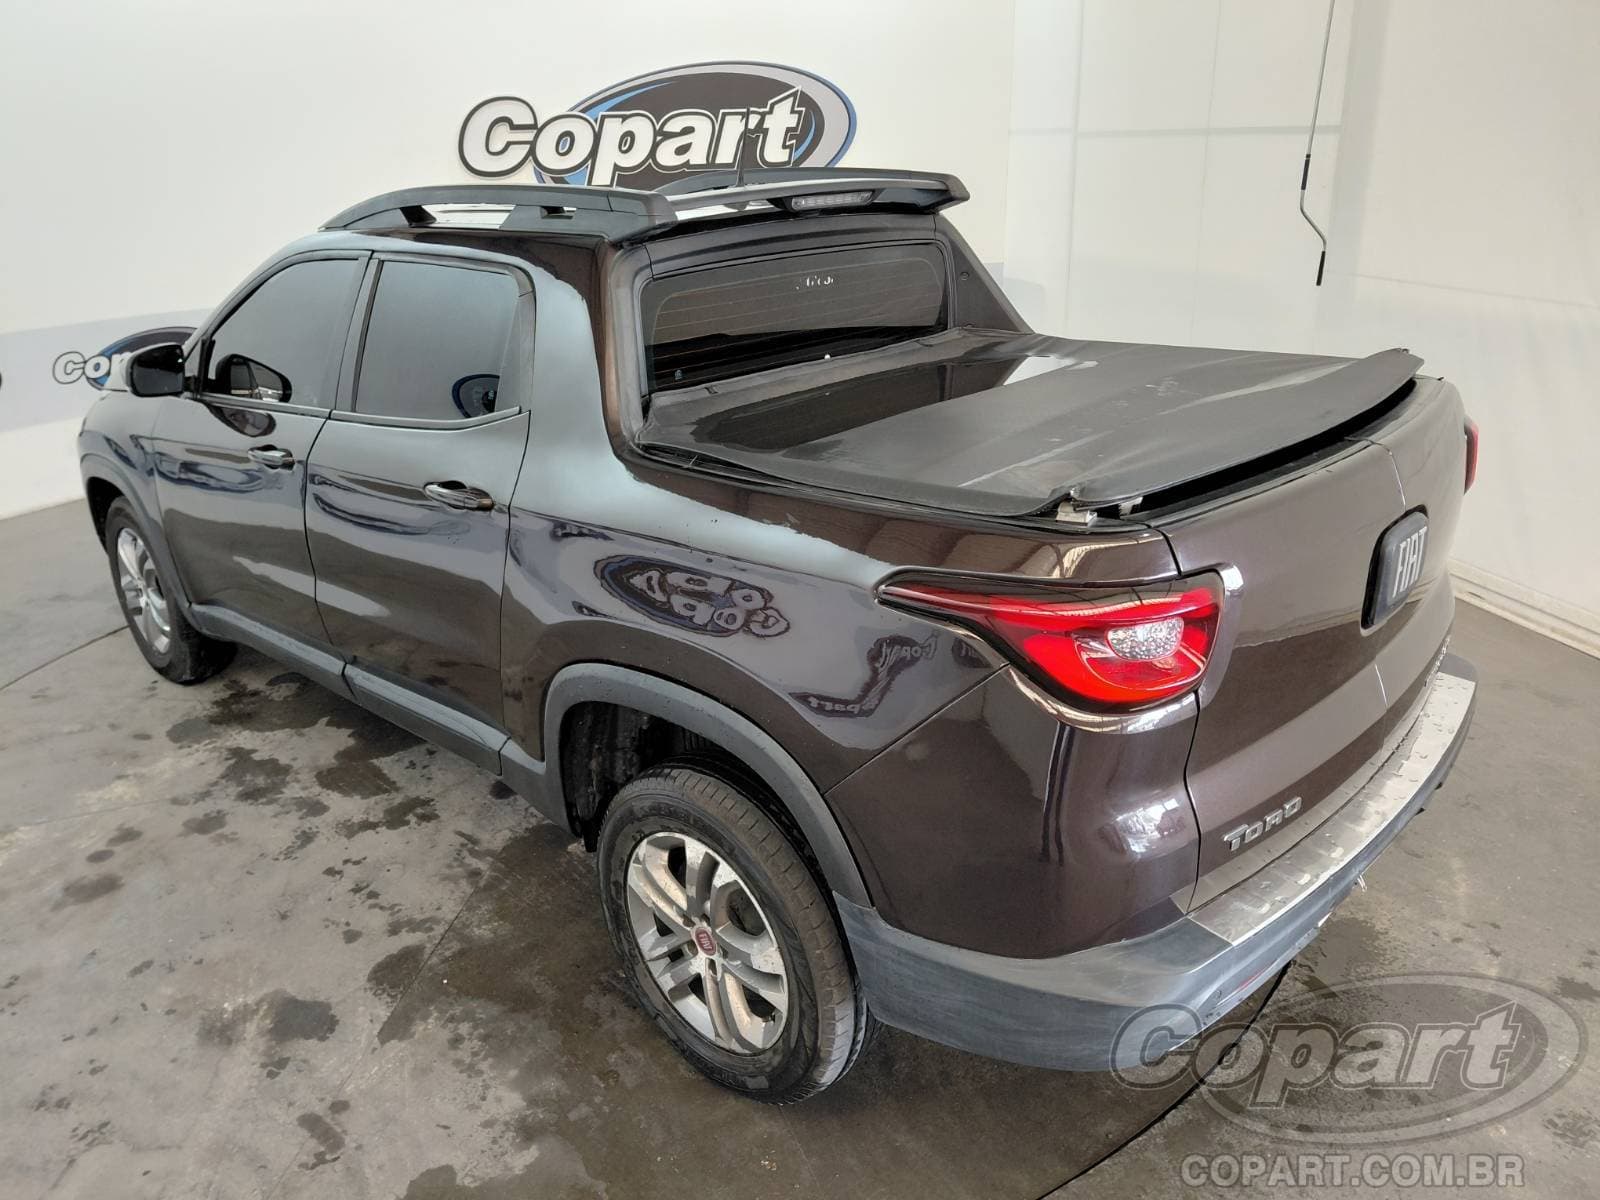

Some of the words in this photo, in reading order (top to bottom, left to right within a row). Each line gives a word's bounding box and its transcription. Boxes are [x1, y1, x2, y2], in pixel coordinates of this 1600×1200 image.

[459, 87, 805, 187] Copart
[1392, 526, 1428, 598] FIAT
[1223, 796, 1302, 851] TORO
